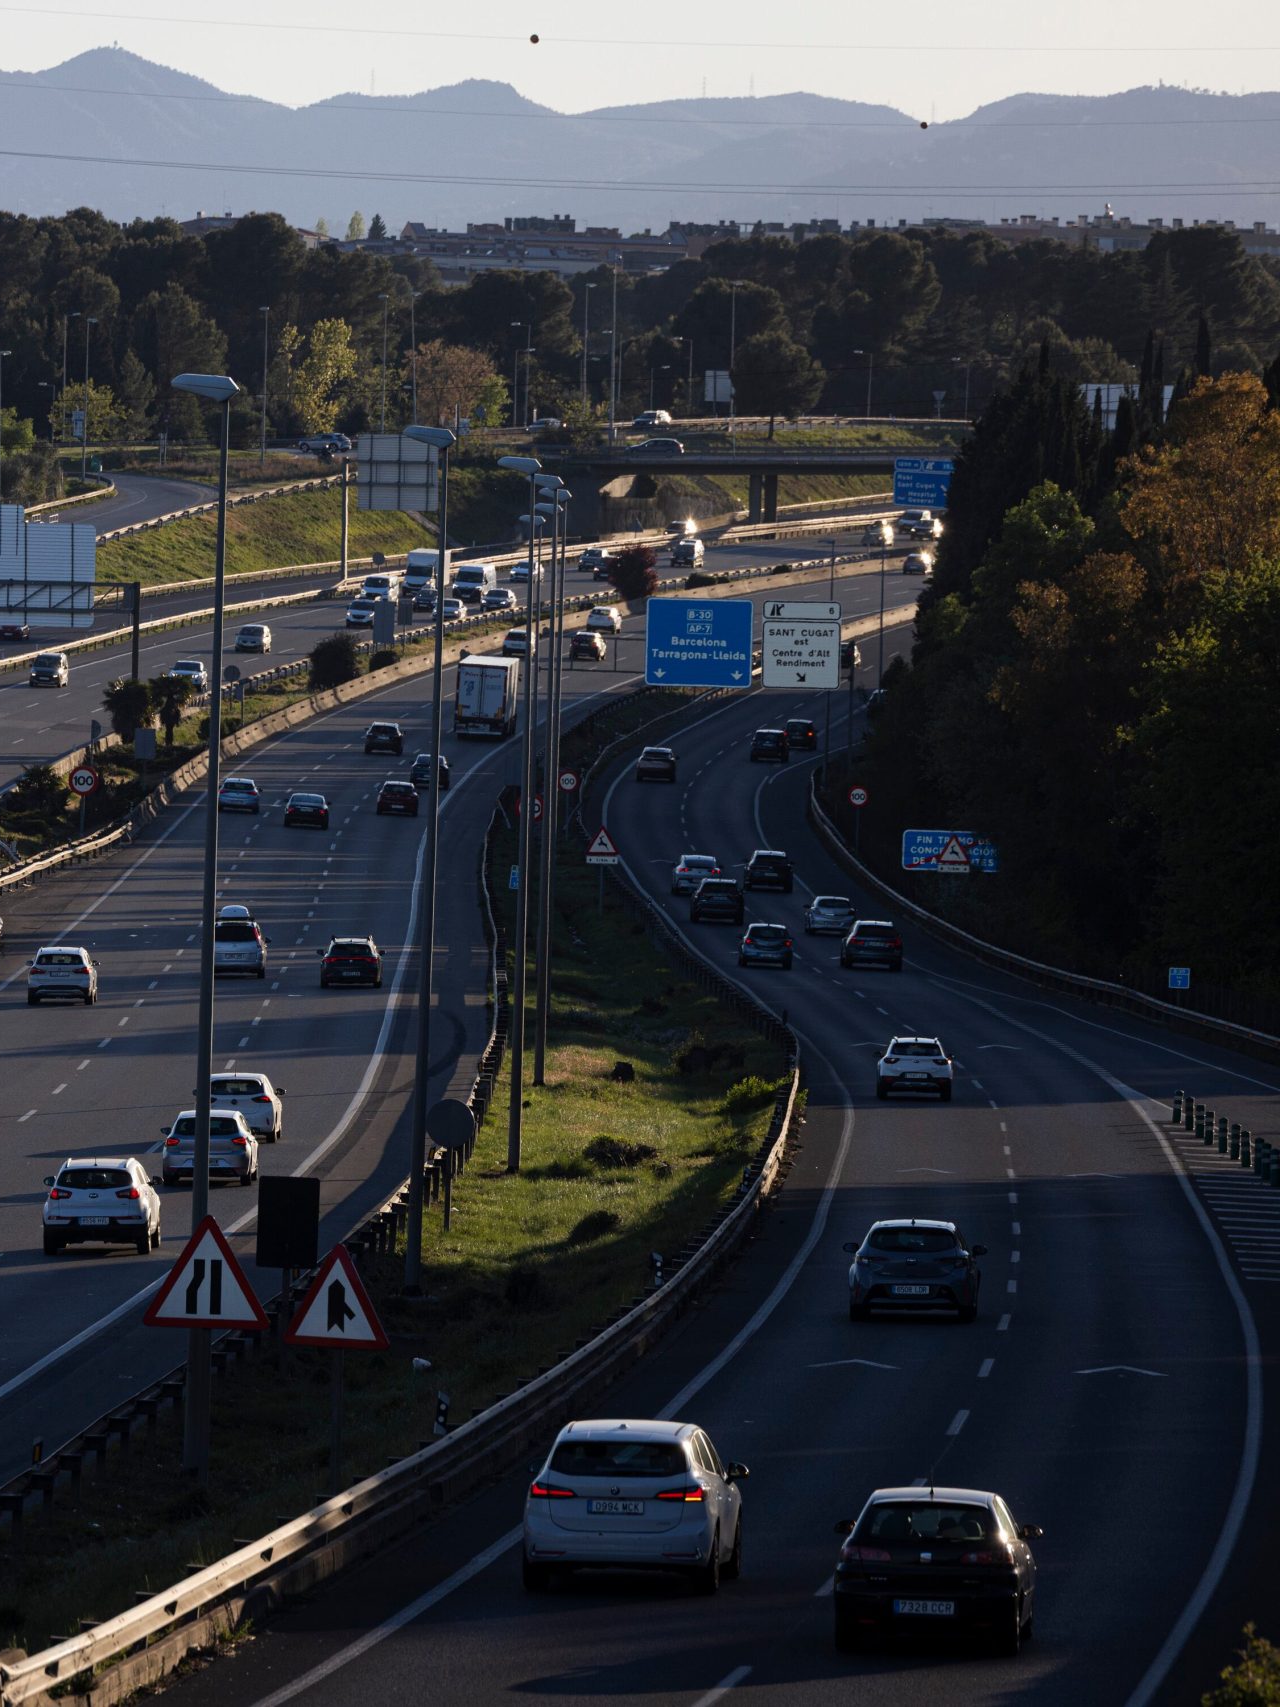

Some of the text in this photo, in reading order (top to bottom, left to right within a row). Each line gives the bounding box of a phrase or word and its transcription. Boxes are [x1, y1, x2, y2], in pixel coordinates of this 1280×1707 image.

[688, 610, 711, 619] B-30
[828, 607, 835, 615] 6
[688, 625, 711, 633] AP-7
[769, 629, 835, 637] SANT CUGAT
[671, 636, 727, 647] Barcelona
[793, 638, 809, 646] est
[651, 648, 747, 661] Tarragona-Lleida
[772, 649, 830, 658] Centre d'Alt
[776, 659, 825, 667] Rendiment
[73, 775, 94, 786] 100
[561, 777, 575, 786] 100
[851, 792, 866, 801] 100
[916, 835, 933, 844] FIN
[937, 836, 974, 845] TRMO
[912, 856, 926, 865] DE
[595, 1501, 640, 1512] 0994 MCK
[900, 1601, 952, 1613] 7328 CCR
